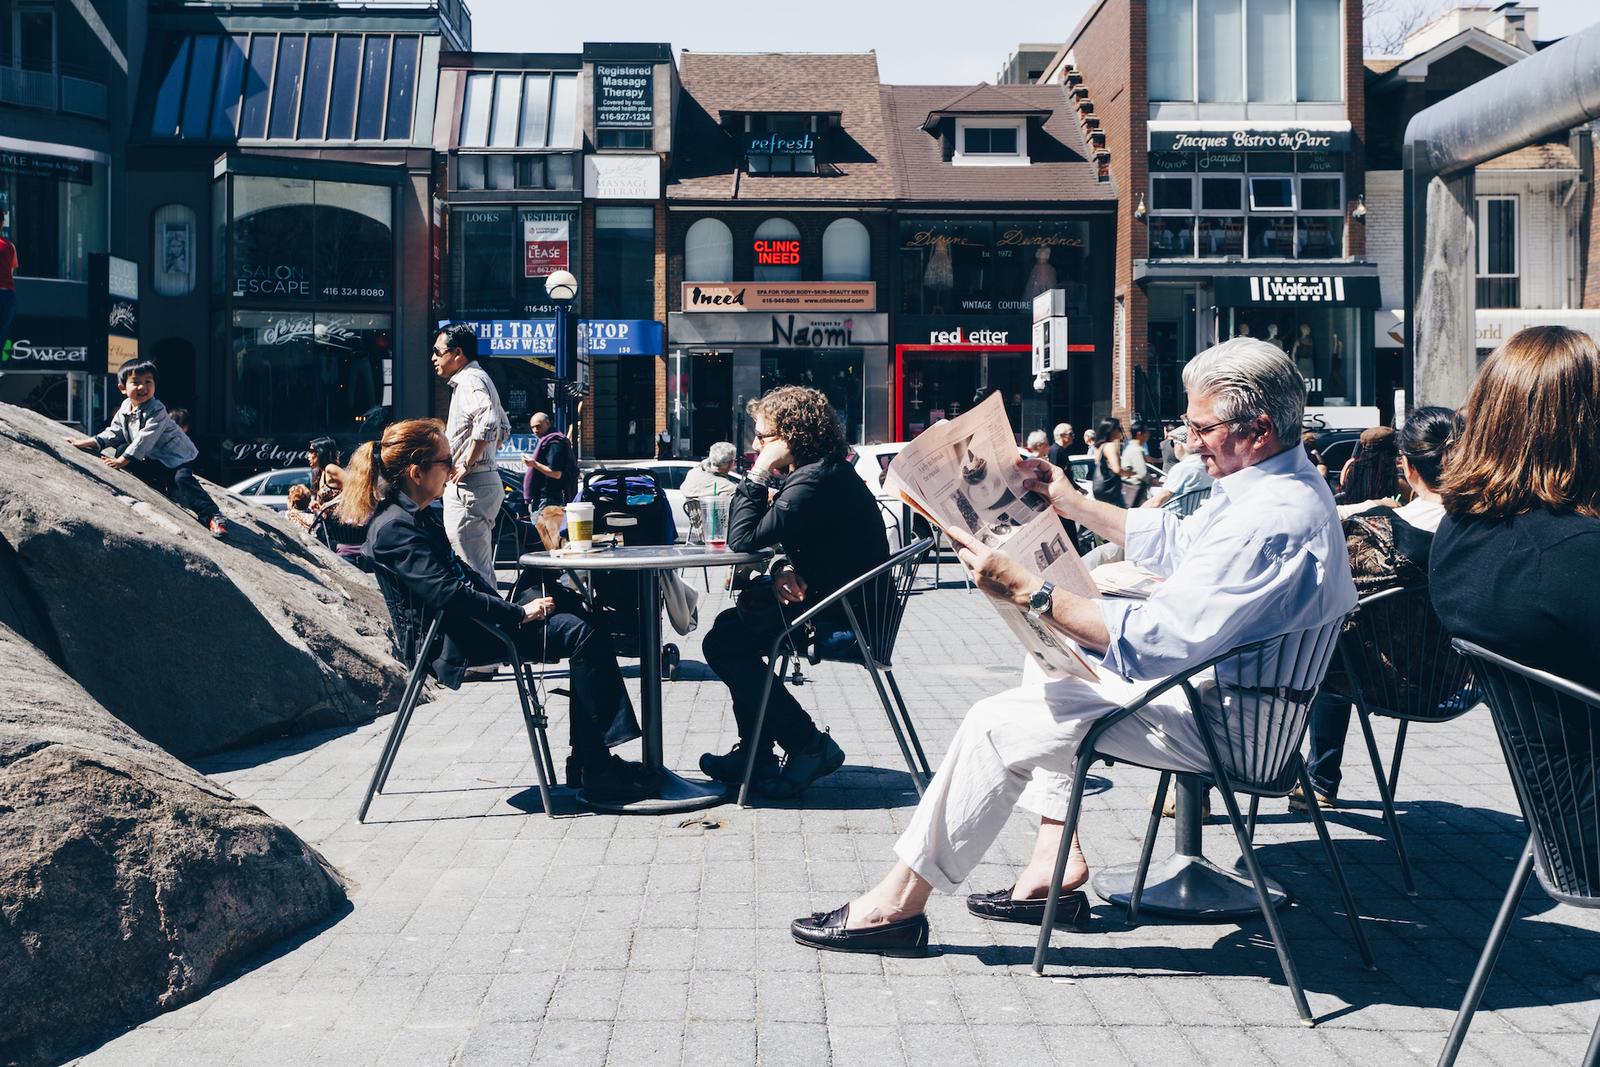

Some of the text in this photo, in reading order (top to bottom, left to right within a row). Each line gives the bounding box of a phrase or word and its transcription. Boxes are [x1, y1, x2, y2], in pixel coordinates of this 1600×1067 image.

[597, 66, 651, 77] Registered
[602, 77, 647, 88] Massage
[603, 88, 644, 99] Therapy
[625, 99, 632, 107] by
[751, 132, 814, 154] refresh
[1172, 131, 1331, 151] Jacques Bistro du Parc
[0, 154, 27, 167] TYLE
[1156, 159, 1189, 170] LIQUOR
[1199, 151, 1242, 169] Jacques
[466, 213, 500, 222] LOOKS
[520, 213, 576, 222] AESTHETIC
[753, 240, 800, 252] CLINIC
[528, 249, 560, 259] LEASE
[758, 253, 801, 265] INEED
[241, 265, 305, 280] SALON
[236, 279, 311, 295] ESCAPE
[323, 287, 385, 298] 416 324 8080
[1270, 283, 1324, 296] Wolford
[692, 287, 746, 305] Ineed
[962, 301, 1031, 310] VINTAGE COUTURE
[510, 322, 556, 338] TRAV
[772, 315, 854, 347] Naomi
[930, 327, 1009, 345] redLetter
[1475, 323, 1502, 339] orld
[11, 340, 88, 361] Sweet
[490, 339, 520, 350] EAST
[521, 339, 554, 350] WEST
[496, 437, 538, 452] SALE
